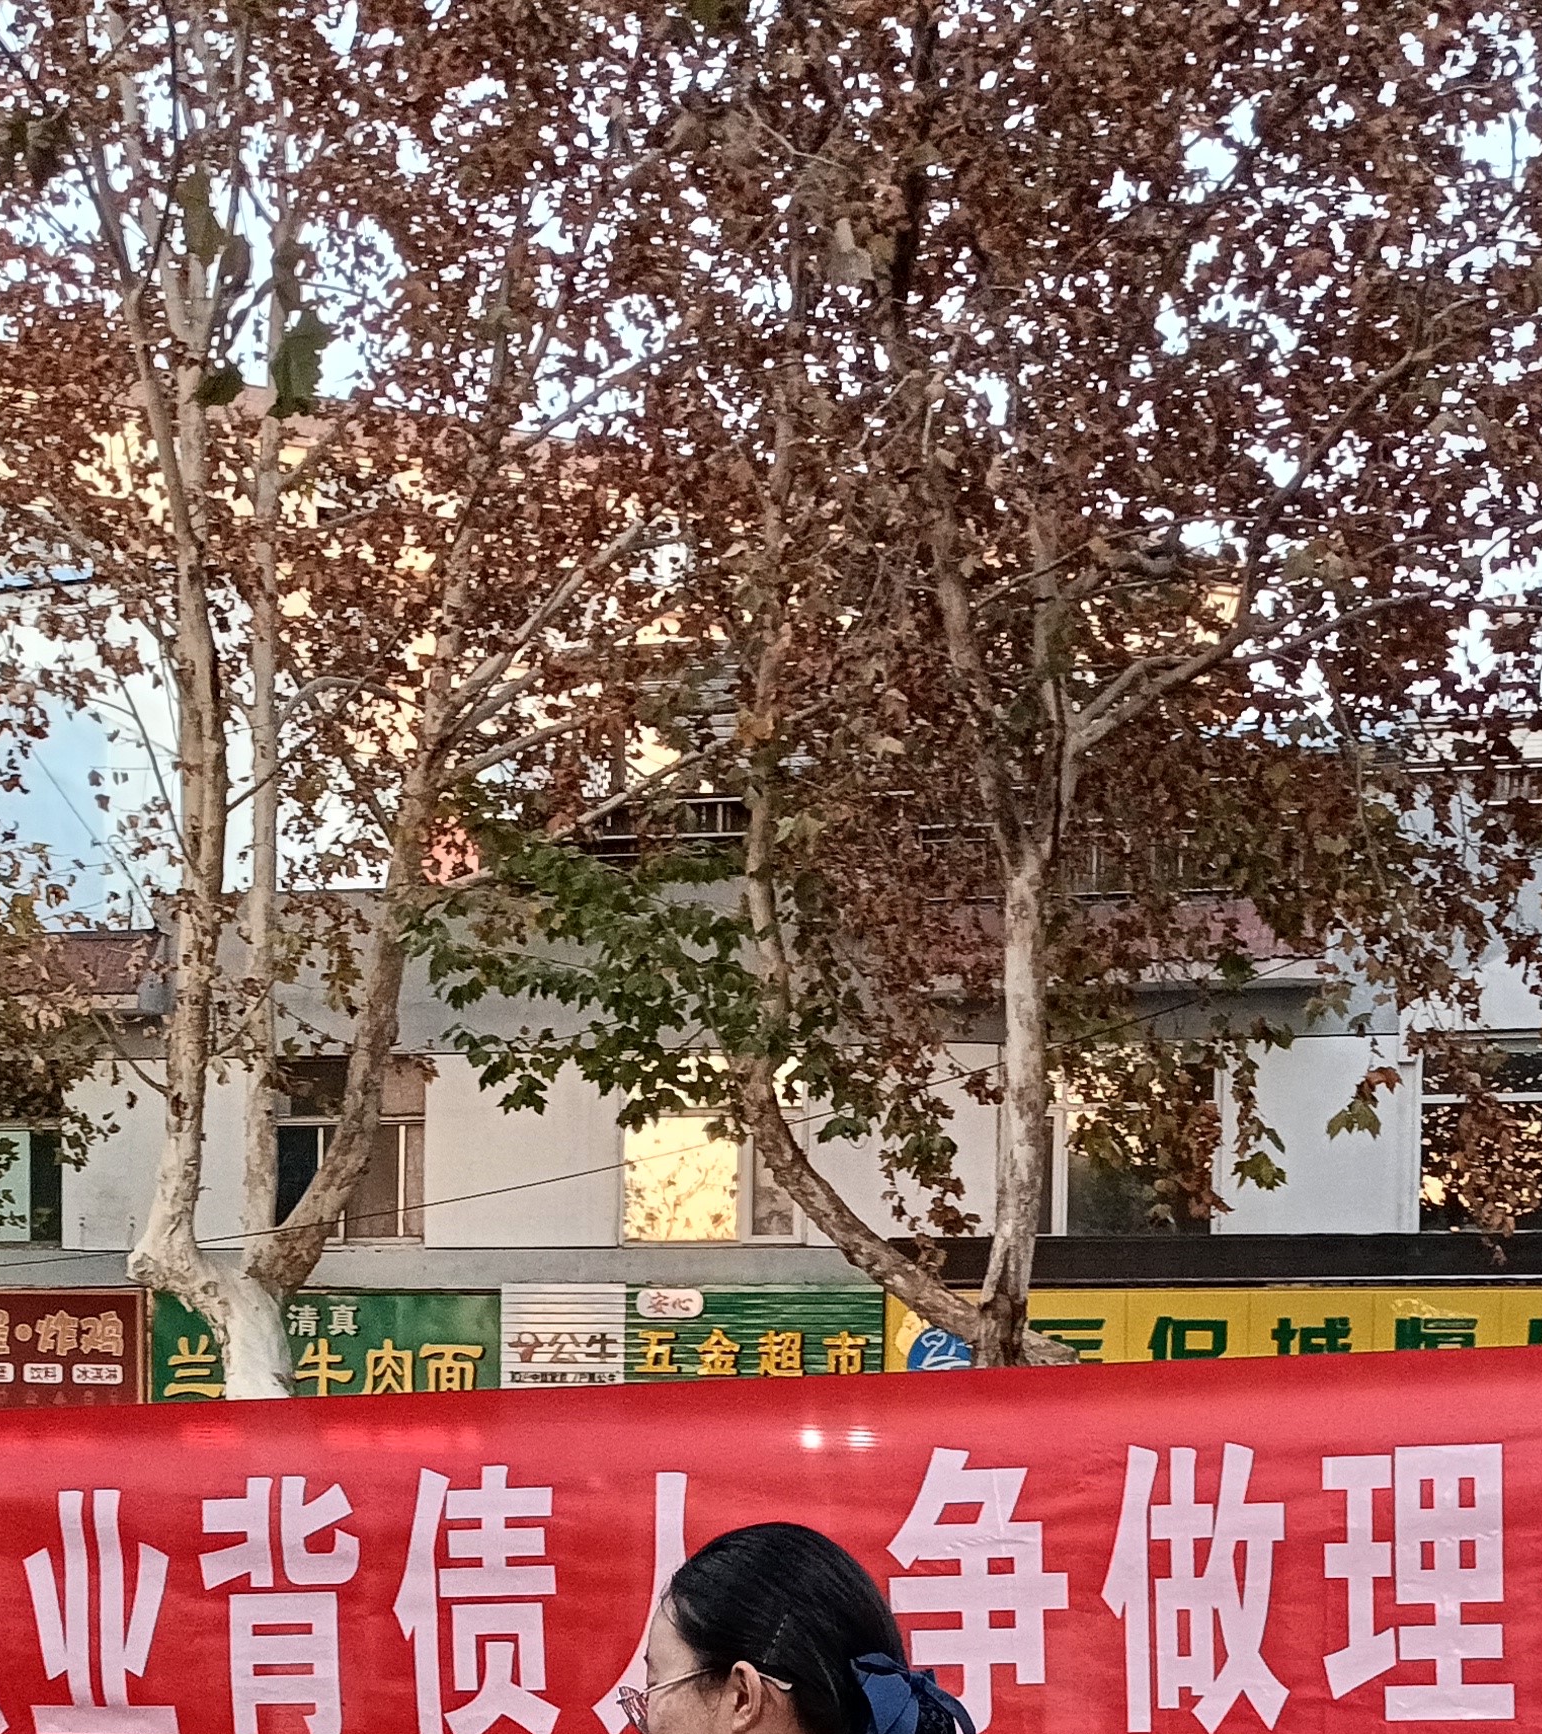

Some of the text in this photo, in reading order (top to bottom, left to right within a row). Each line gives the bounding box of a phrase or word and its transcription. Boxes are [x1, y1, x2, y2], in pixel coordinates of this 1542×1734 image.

[287, 1304, 360, 1336] 清真
[164, 1336, 484, 1397] 兰牛肉面
[635, 1329, 868, 1377] 五金超市
